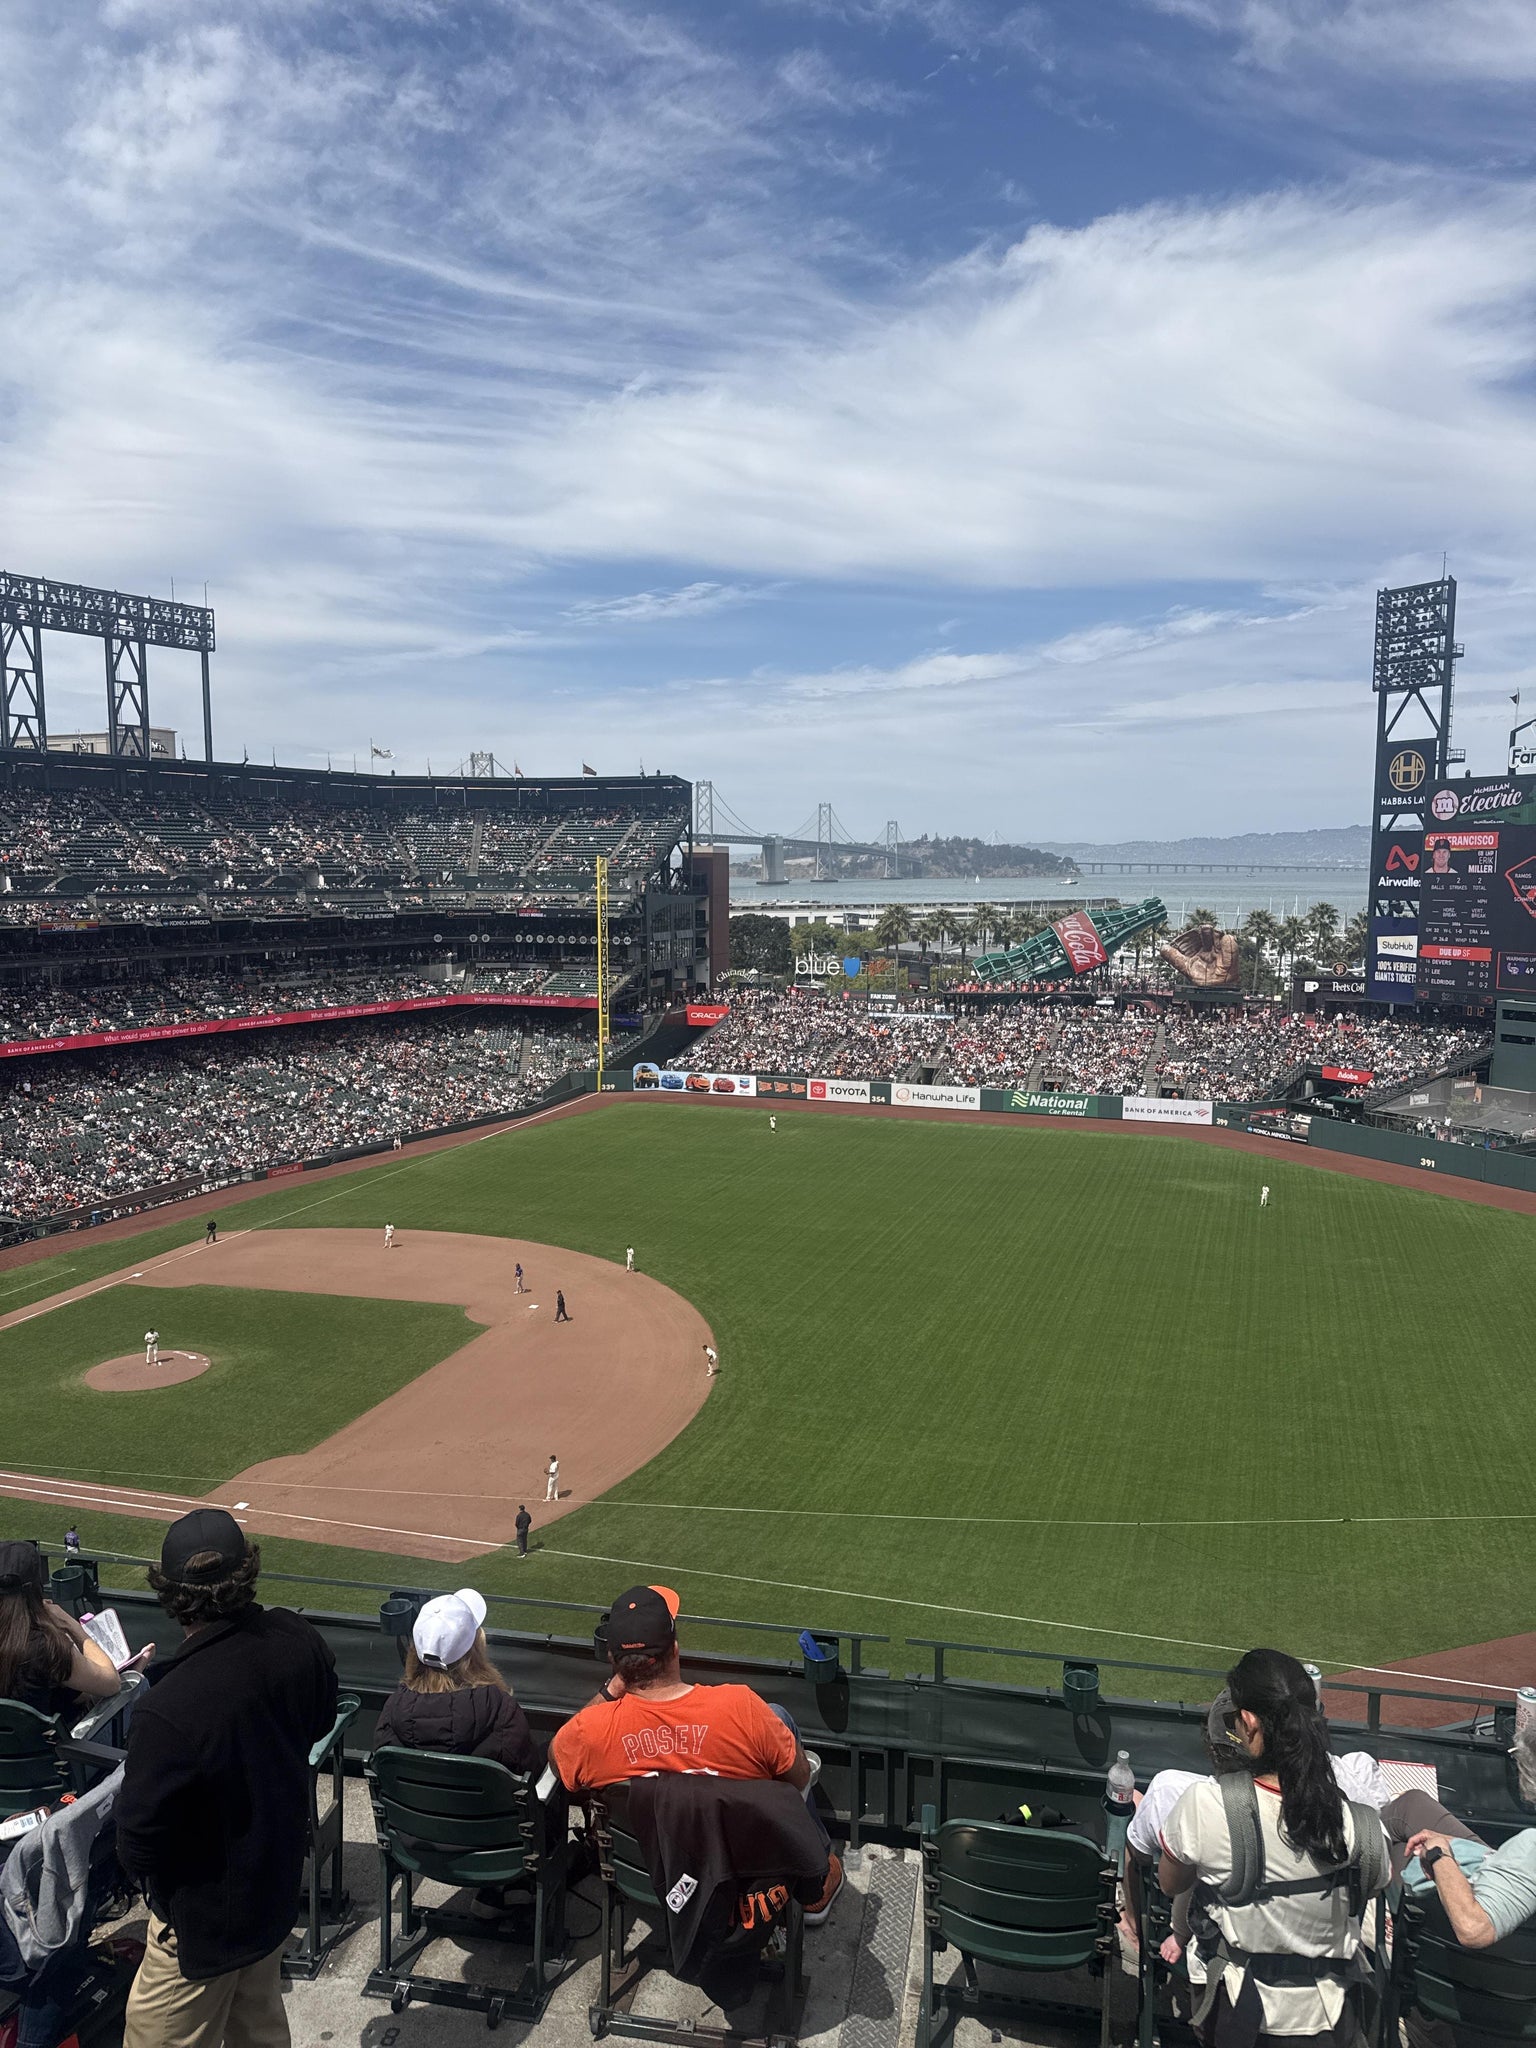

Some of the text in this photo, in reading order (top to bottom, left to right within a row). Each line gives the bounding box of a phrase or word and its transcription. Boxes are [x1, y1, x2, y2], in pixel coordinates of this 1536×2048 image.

[1473, 783, 1510, 795] McMILLAN
[1381, 796, 1411, 805] HABBAS
[1460, 788, 1522, 814] Electric
[1447, 835, 1494, 846] FRANCISCO
[1478, 856, 1493, 864] ERIK
[1468, 864, 1493, 873] MILLER
[1382, 941, 1413, 950] StubHub
[1439, 948, 1451, 956] DUE
[1462, 949, 1471, 957] SF
[796, 956, 840, 975] blue
[1377, 960, 1417, 973] 100% VERIFIED
[1374, 971, 1395, 982] GIANTS
[1430, 978, 1455, 986] ELDRIDGE
[324, 1010, 337, 1018] would
[363, 1006, 376, 1014] power
[104, 1035, 119, 1043] What
[120, 1033, 138, 1041] would
[139, 1032, 150, 1040] you
[151, 1029, 161, 1037] like
[162, 1028, 171, 1036] the
[172, 1027, 189, 1036] power
[197, 1024, 207, 1032] do?
[1337, 1071, 1359, 1081] Adobe
[829, 1086, 867, 1097] TOYOTA
[912, 1091, 975, 1104] Hanwha Life
[1029, 1094, 1088, 1110] National
[1062, 1109, 1085, 1117] Rental
[1158, 1109, 1192, 1117] AMERICA
[1216, 1118, 1228, 1126] 399
[1253, 1128, 1270, 1136] KONICA
[1271, 1131, 1292, 1141] MINOLTA
[1420, 1158, 1435, 1168] 391
[271, 1165, 299, 1176] ORACLE
[621, 1725, 708, 1764] POSEY
